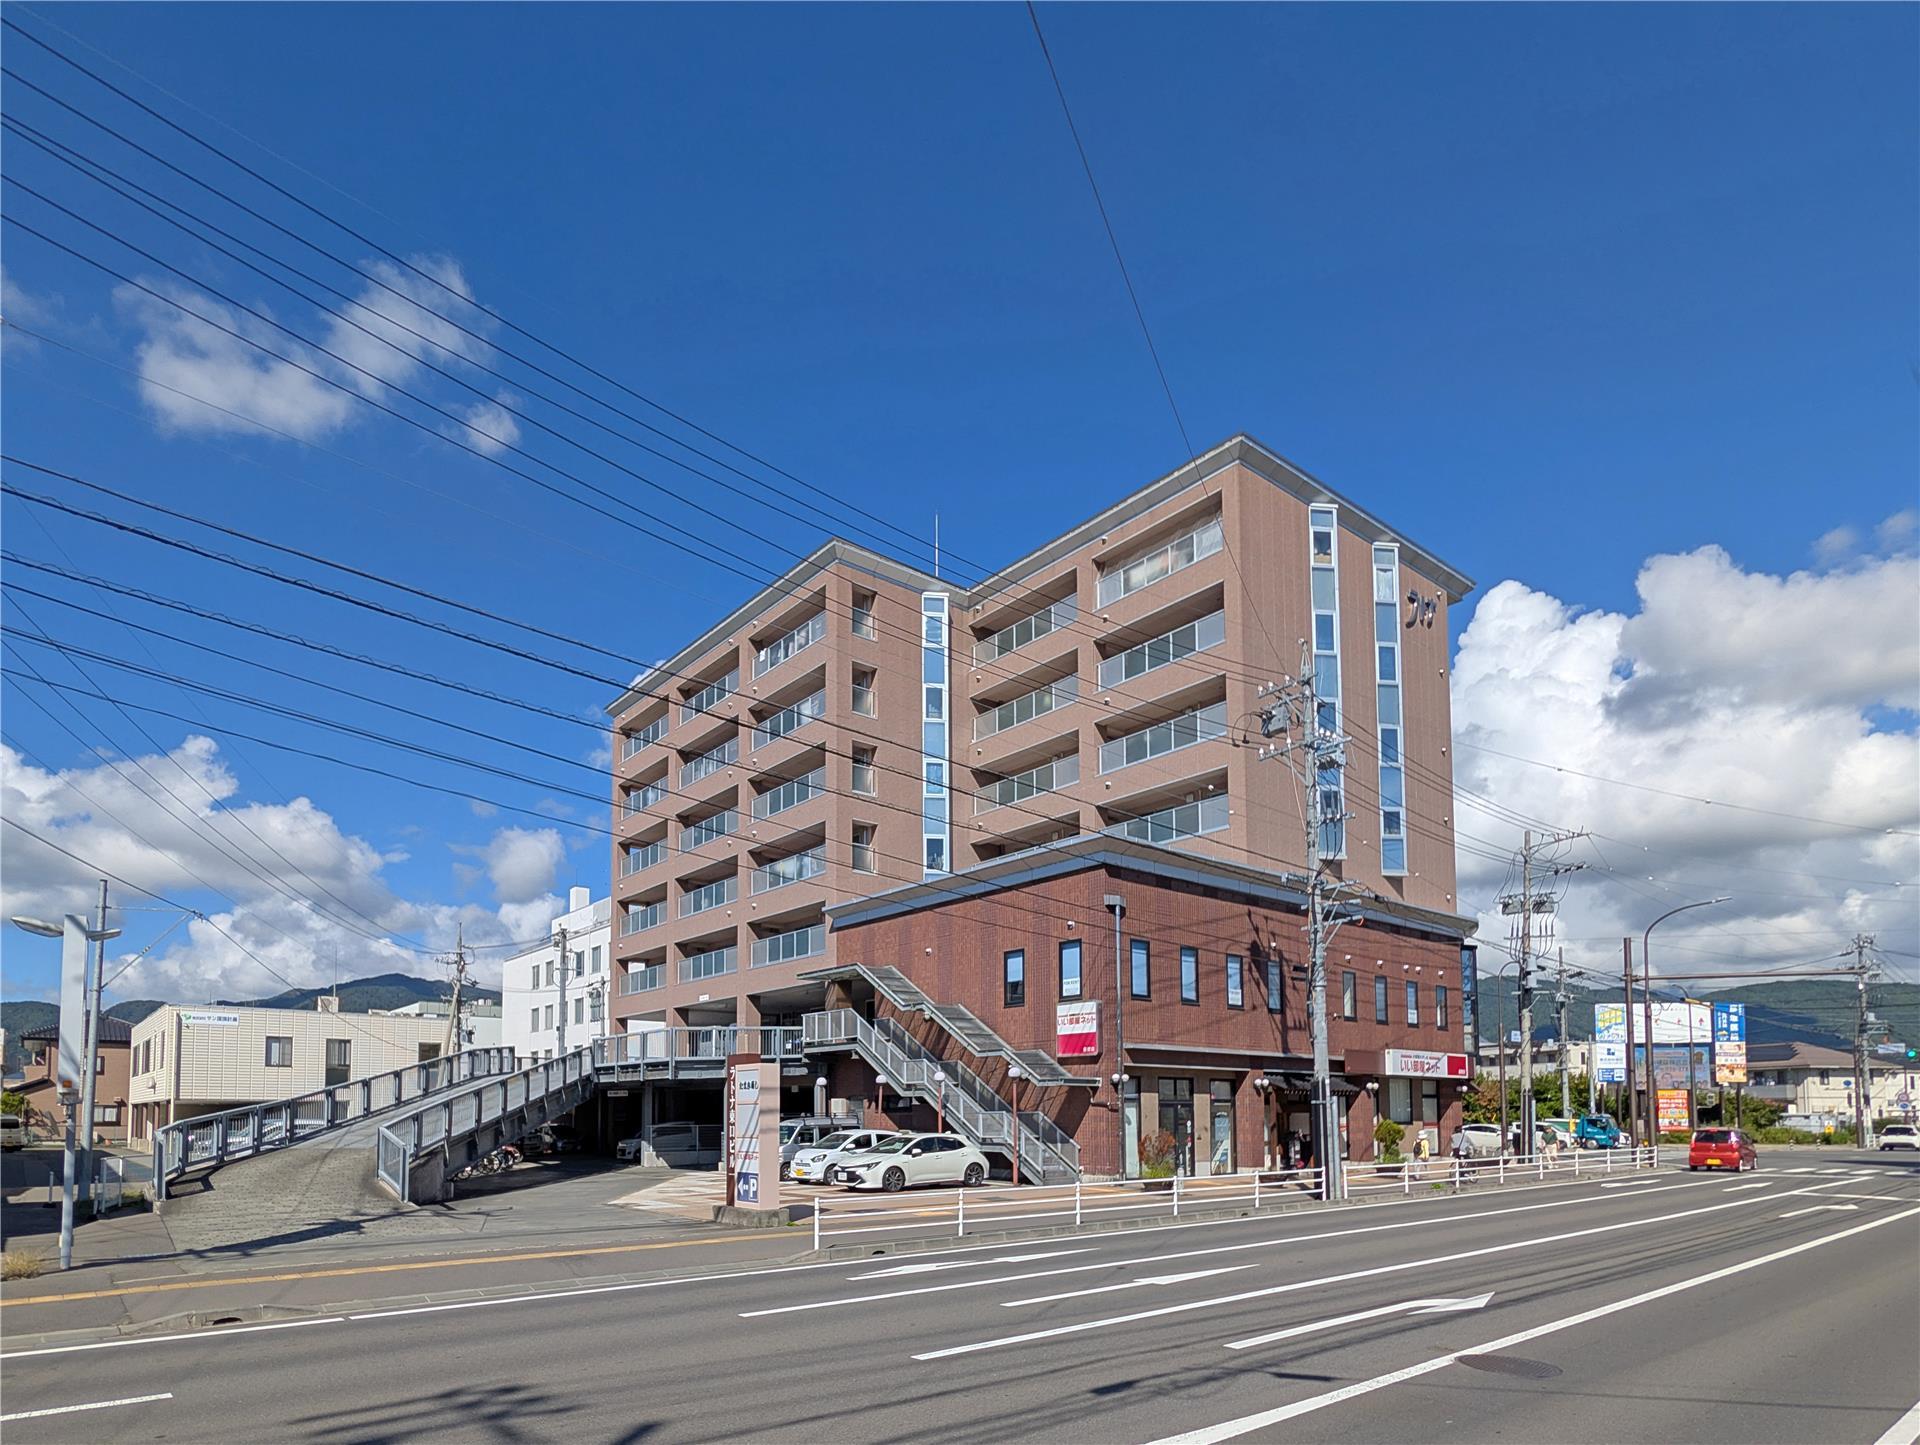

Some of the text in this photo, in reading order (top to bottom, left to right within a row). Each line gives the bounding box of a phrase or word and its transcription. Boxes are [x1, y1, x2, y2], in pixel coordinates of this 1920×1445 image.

[1057, 1015, 1096, 1027] いい部屋ネット
[1400, 1059, 1441, 1073] いい部屋ネット
[750, 1178, 757, 1198] P
